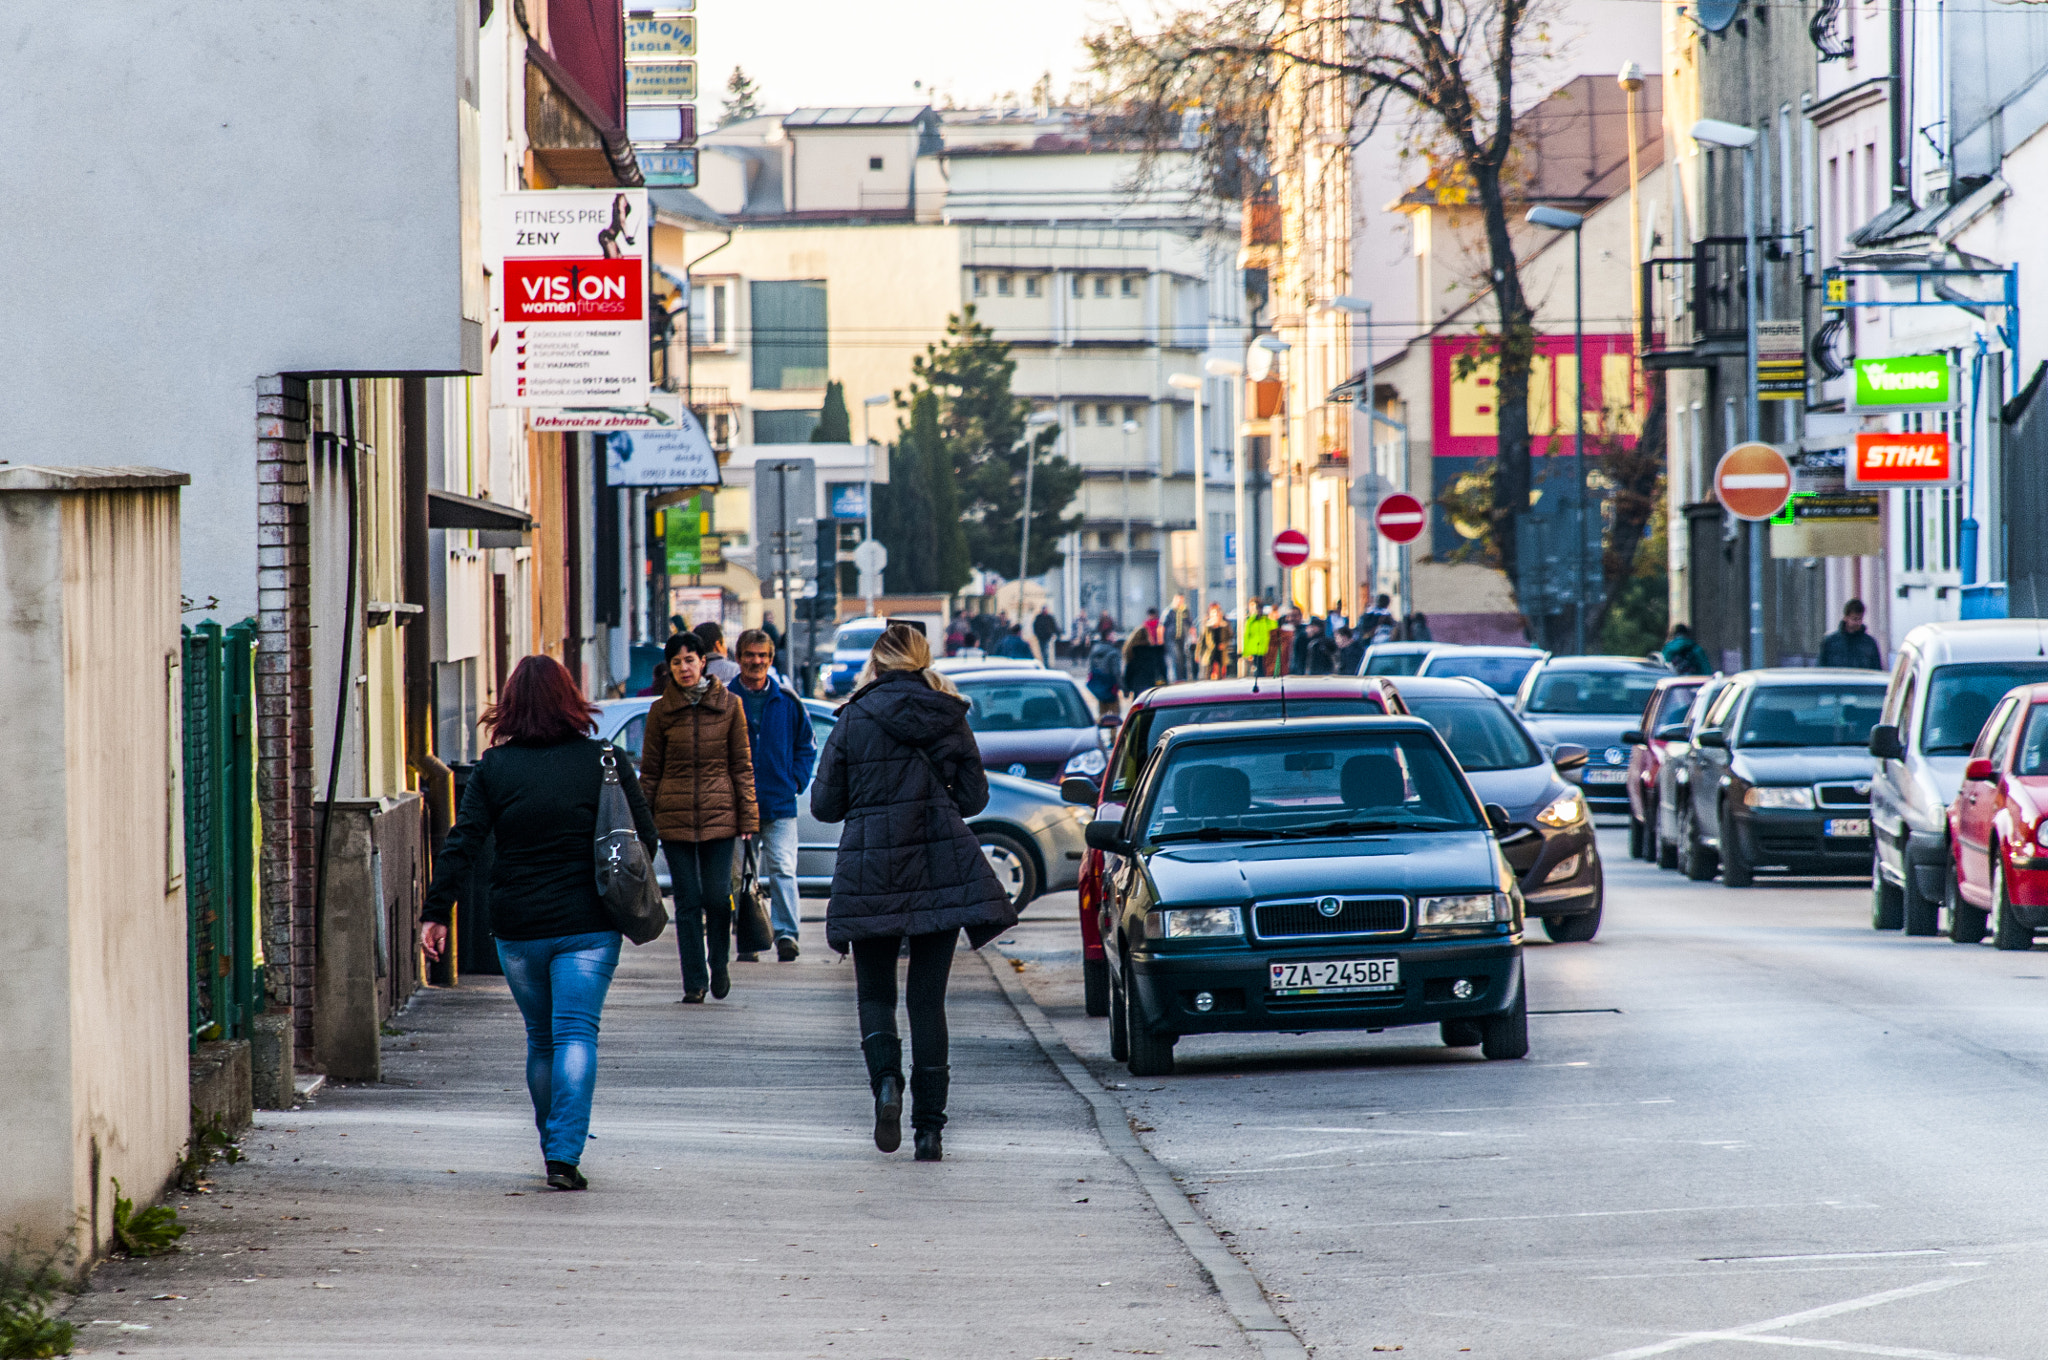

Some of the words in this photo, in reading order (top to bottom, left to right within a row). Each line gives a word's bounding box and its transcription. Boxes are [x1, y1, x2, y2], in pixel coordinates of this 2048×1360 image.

[515, 209, 575, 224] FITNESS
[578, 209, 606, 224] PRE
[516, 229, 560, 246] ŽENY
[521, 275, 626, 301] VISION
[1865, 368, 1940, 391] VIKING
[604, 415, 651, 427] zbrane
[1864, 445, 1941, 467] STIHL
[1284, 961, 1396, 987] ZA-245BF
